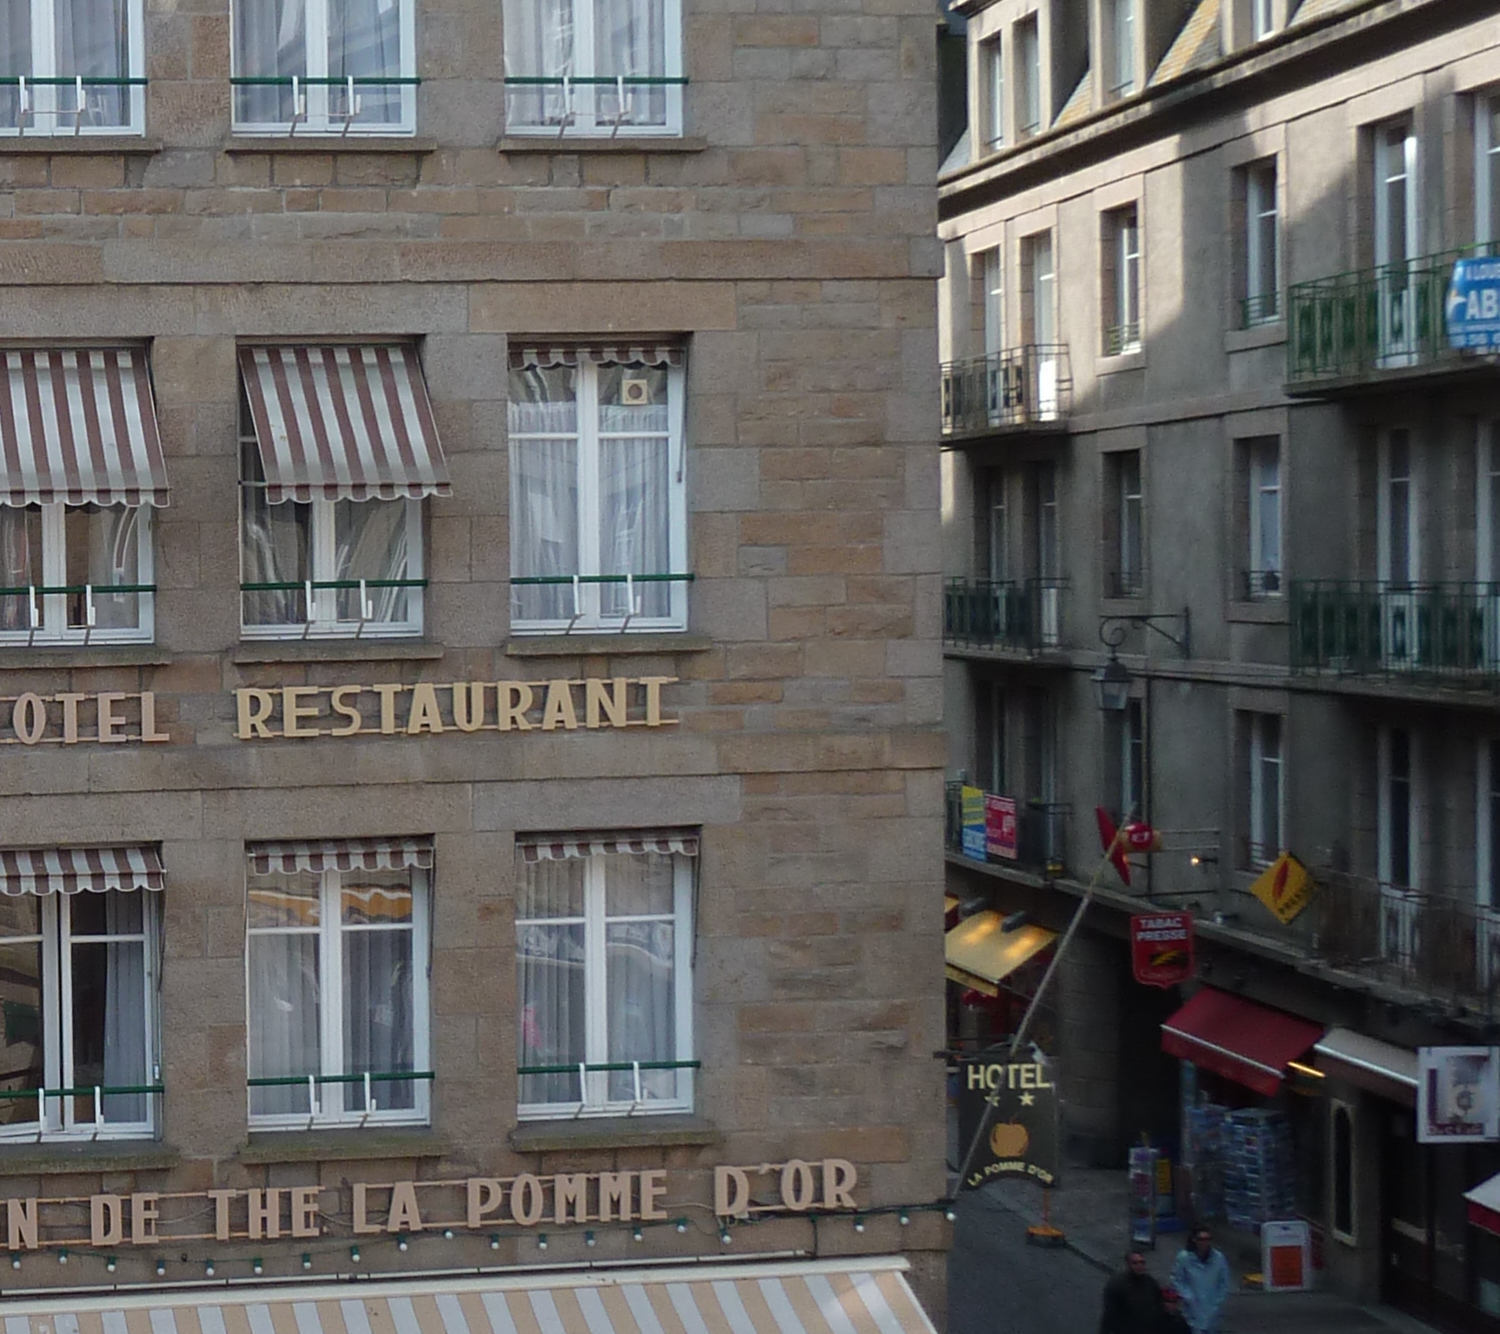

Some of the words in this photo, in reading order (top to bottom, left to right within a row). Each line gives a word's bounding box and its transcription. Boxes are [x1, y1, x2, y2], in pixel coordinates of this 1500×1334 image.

[236, 676, 668, 739] RESTAURANT
[1136, 929, 1188, 942] PRESSE
[1139, 917, 1183, 929] TABAC
[967, 1063, 1051, 1089] HOTEL
[966, 1172, 984, 1186] LA
[983, 1161, 1025, 1176] POMME
[90, 1192, 160, 1246] DE
[206, 1186, 320, 1240] THE
[352, 1180, 423, 1233] LA
[466, 1169, 668, 1228] POMME
[713, 1158, 859, 1217] D'OR
